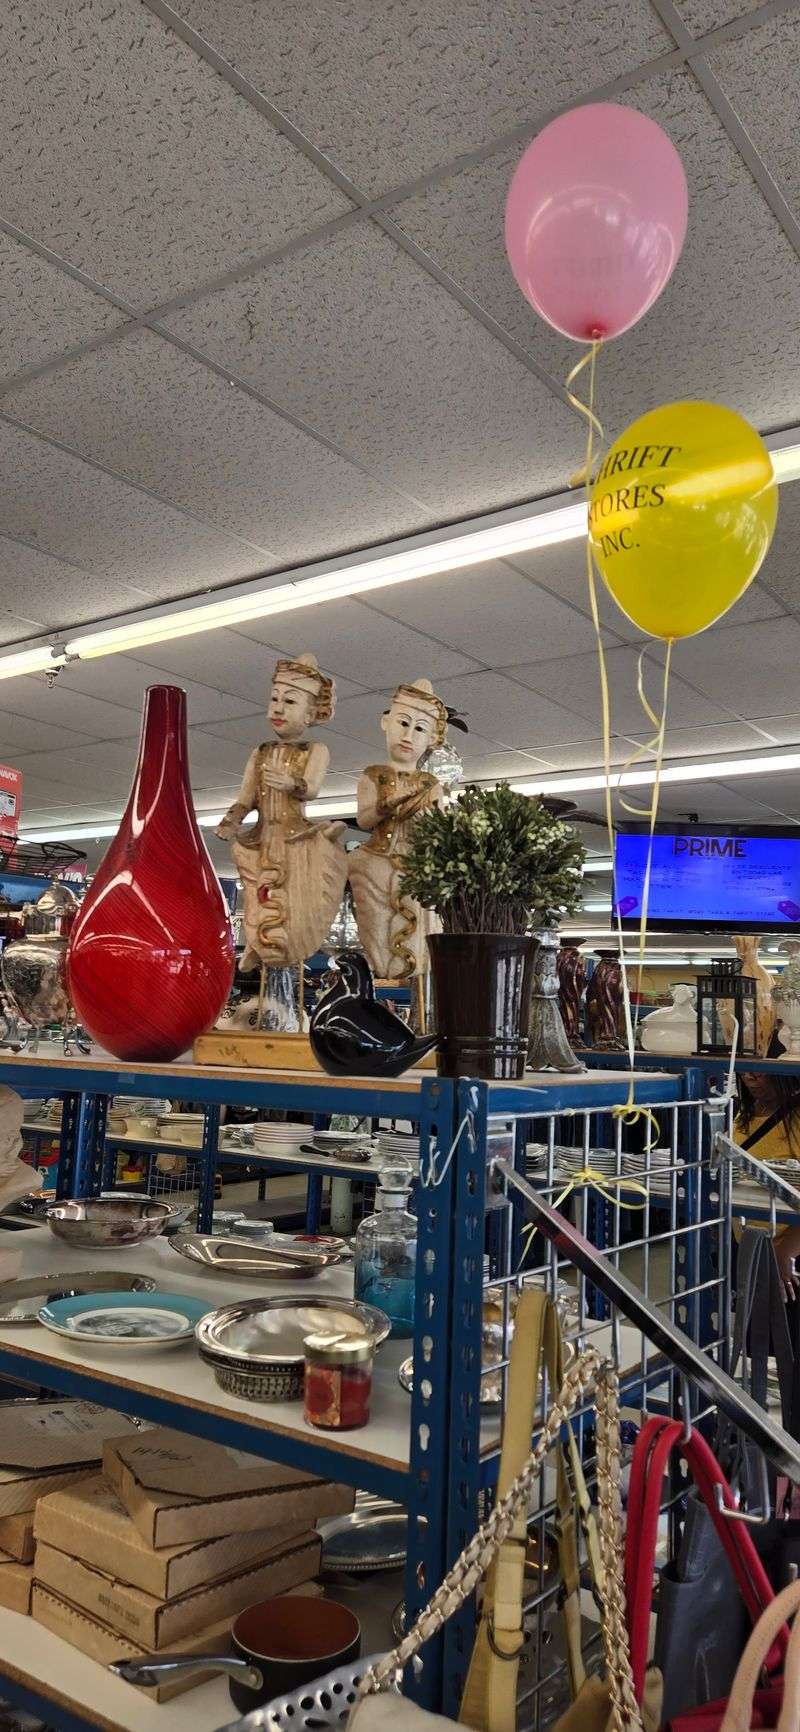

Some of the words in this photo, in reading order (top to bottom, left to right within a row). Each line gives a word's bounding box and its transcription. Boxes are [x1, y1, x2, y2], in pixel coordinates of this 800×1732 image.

[597, 445, 682, 484] HRIFT
[588, 484, 666, 523] TORES
[600, 527, 641, 558] INC.
[673, 837, 748, 858] PRIME
